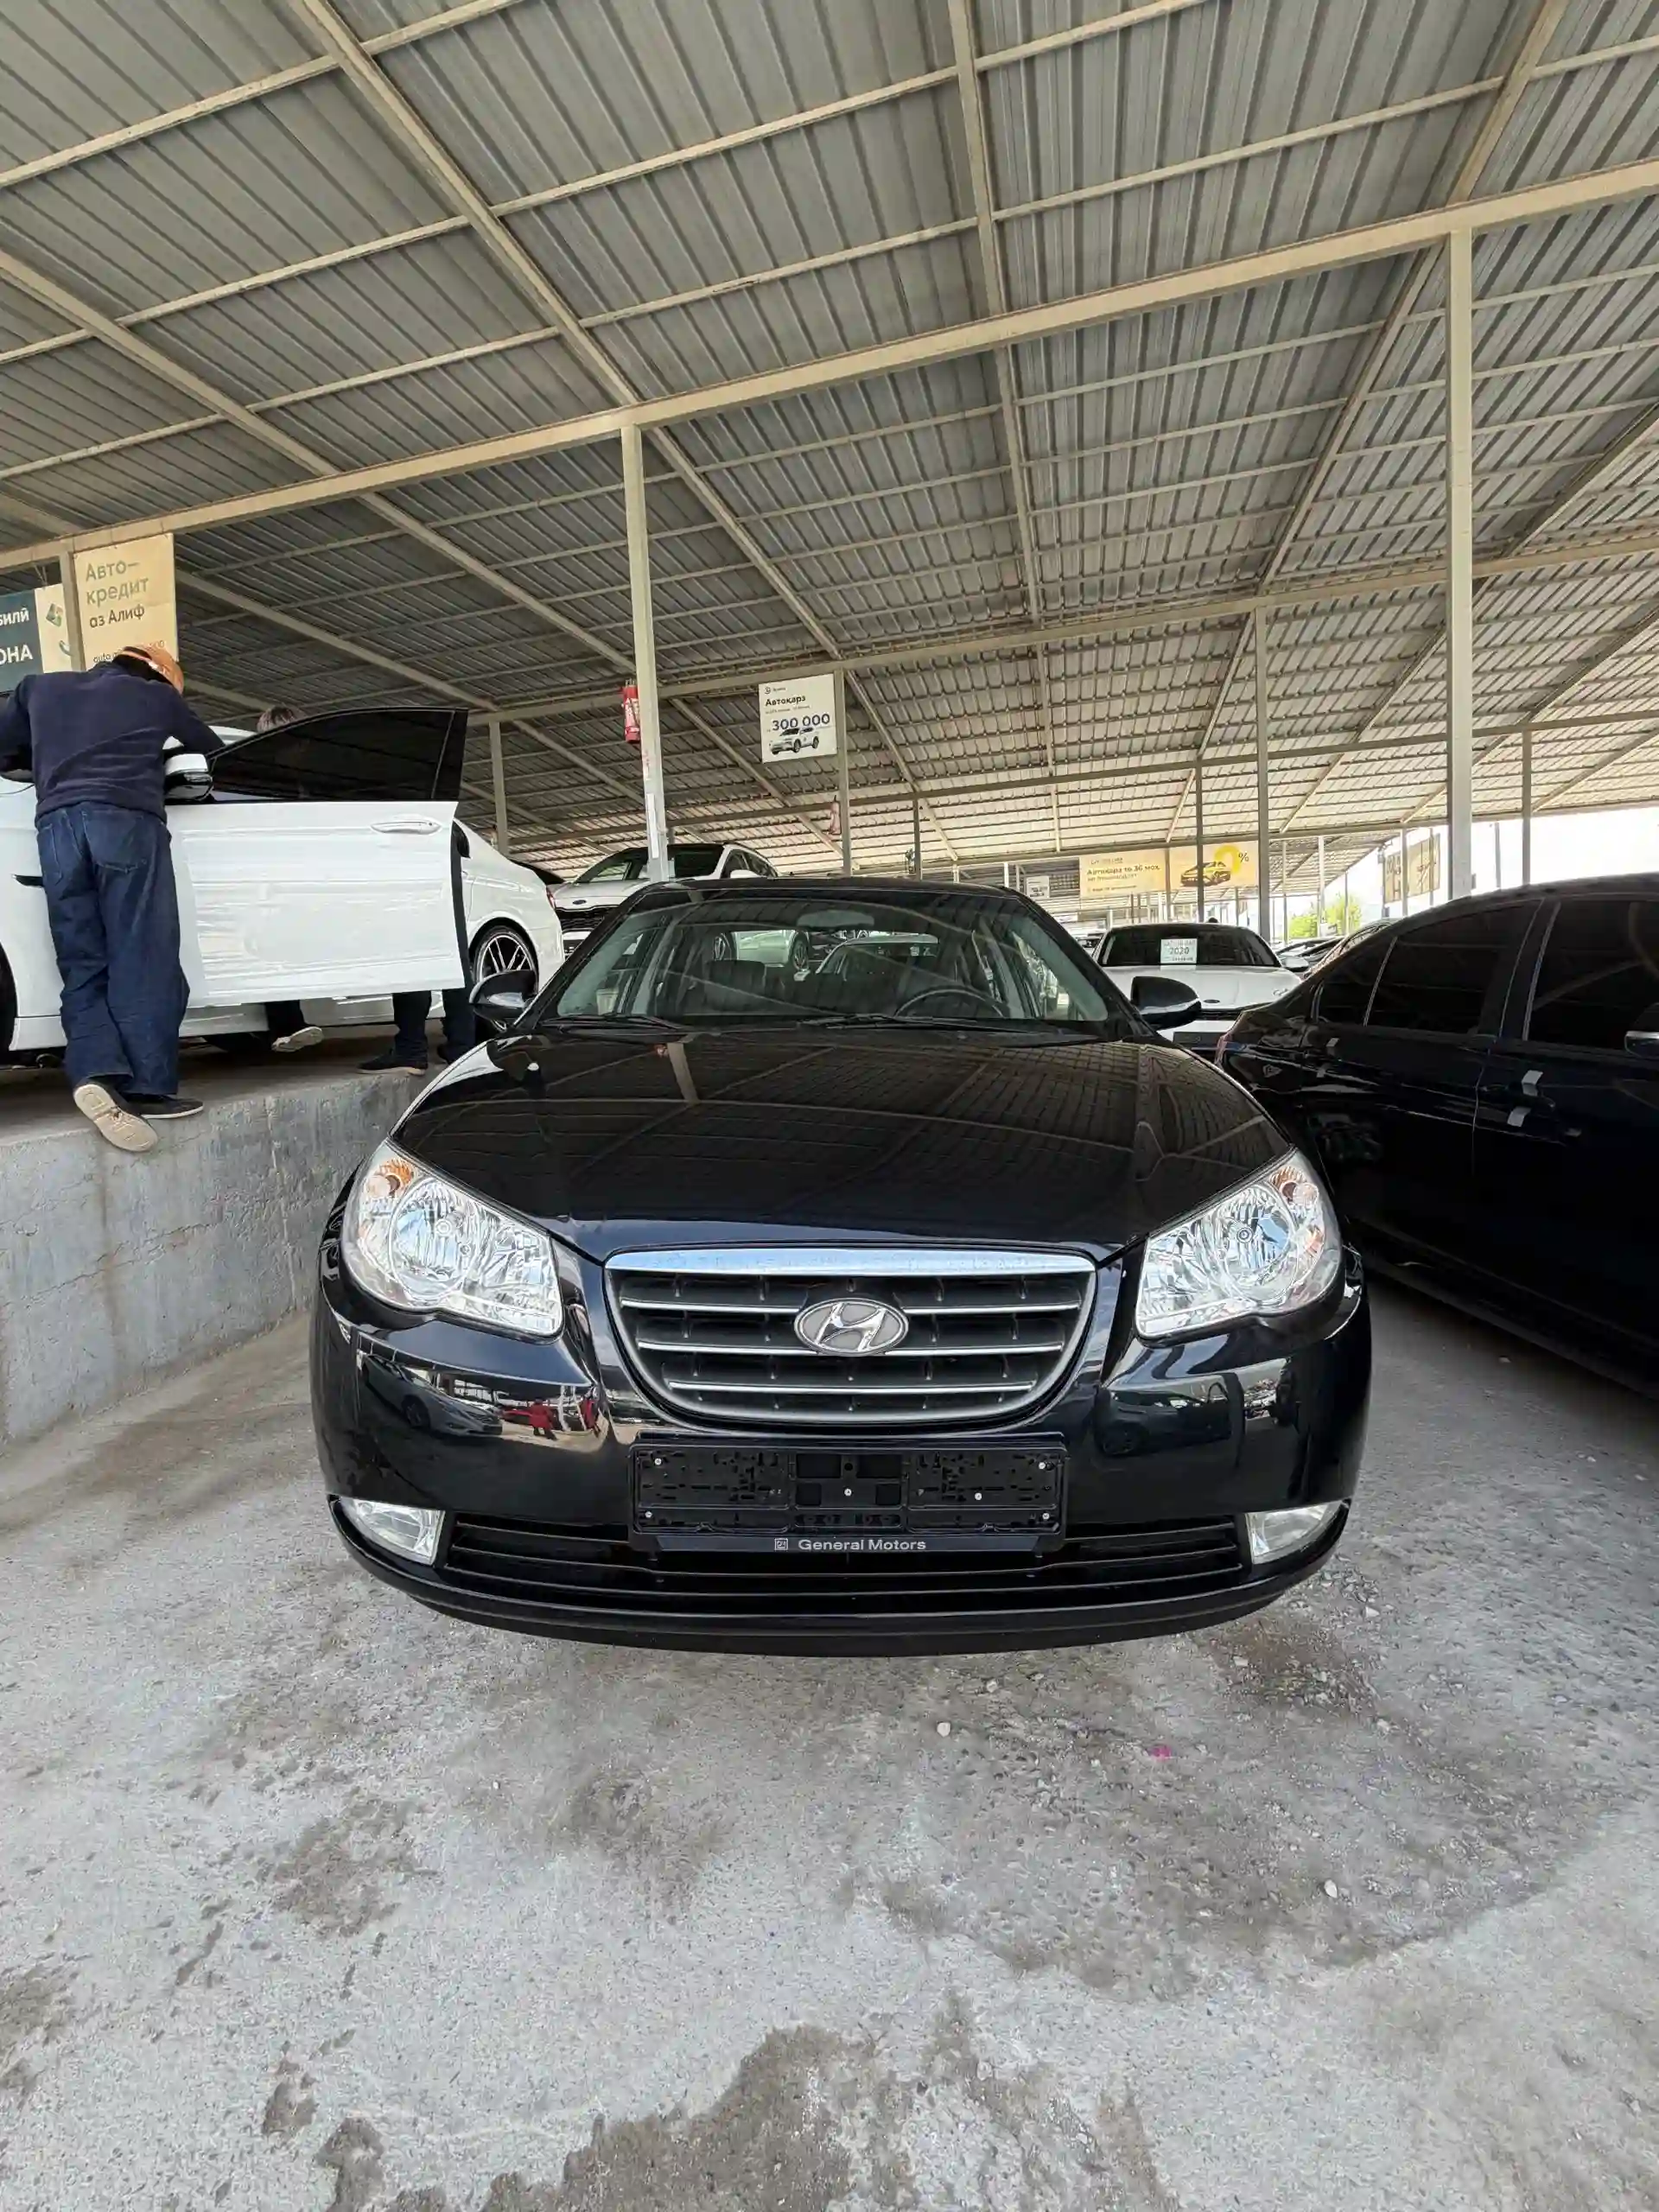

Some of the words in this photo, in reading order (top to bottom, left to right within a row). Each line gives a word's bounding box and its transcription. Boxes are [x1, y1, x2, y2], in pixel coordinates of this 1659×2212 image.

[86, 577, 149, 608] кредит
[90, 615, 105, 628] аз
[109, 604, 144, 624] Алиф
[772, 717, 798, 731] 300
[803, 713, 830, 727] 000
[798, 1539, 864, 1551] General
[868, 1539, 927, 1551] Motors
